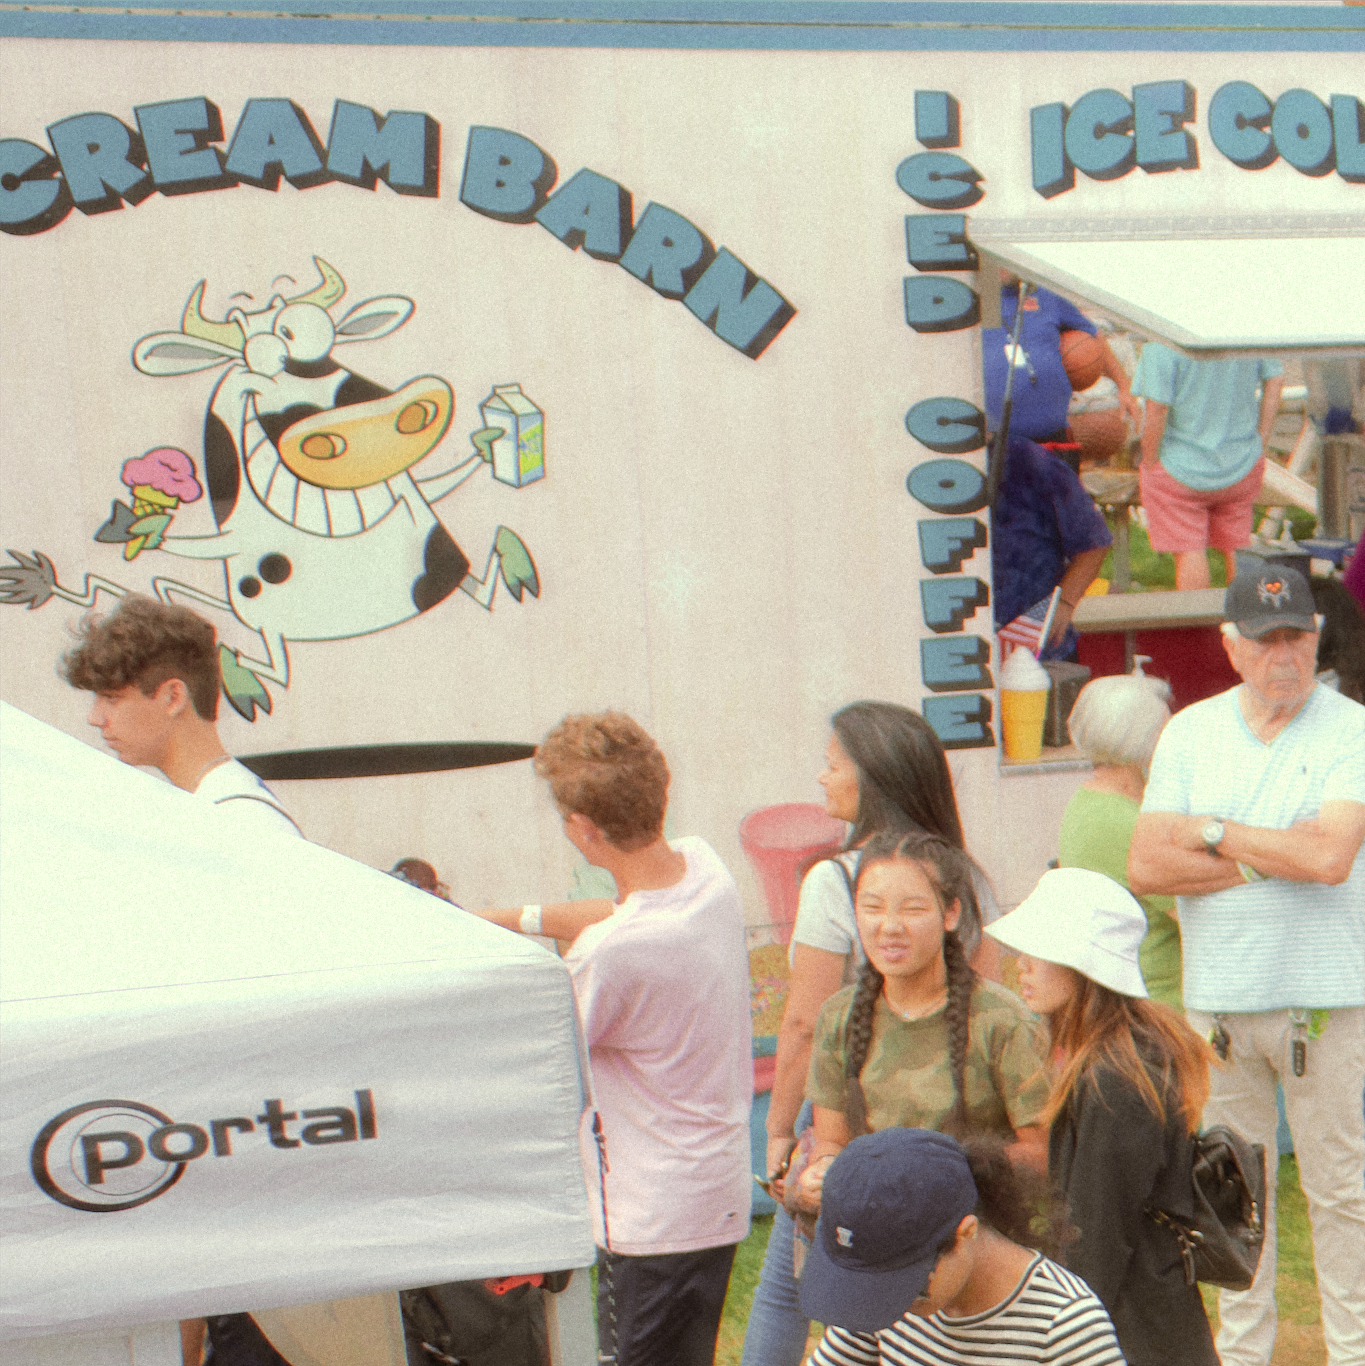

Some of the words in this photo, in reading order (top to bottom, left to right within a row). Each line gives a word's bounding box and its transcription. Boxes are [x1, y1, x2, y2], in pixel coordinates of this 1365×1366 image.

[0, 96, 440, 235] CREAM
[460, 125, 797, 360] BARN
[895, 90, 986, 333] ICED
[1030, 80, 1200, 199] ICE
[905, 396, 996, 750] COFFEE
[79, 1088, 379, 1185] portal
